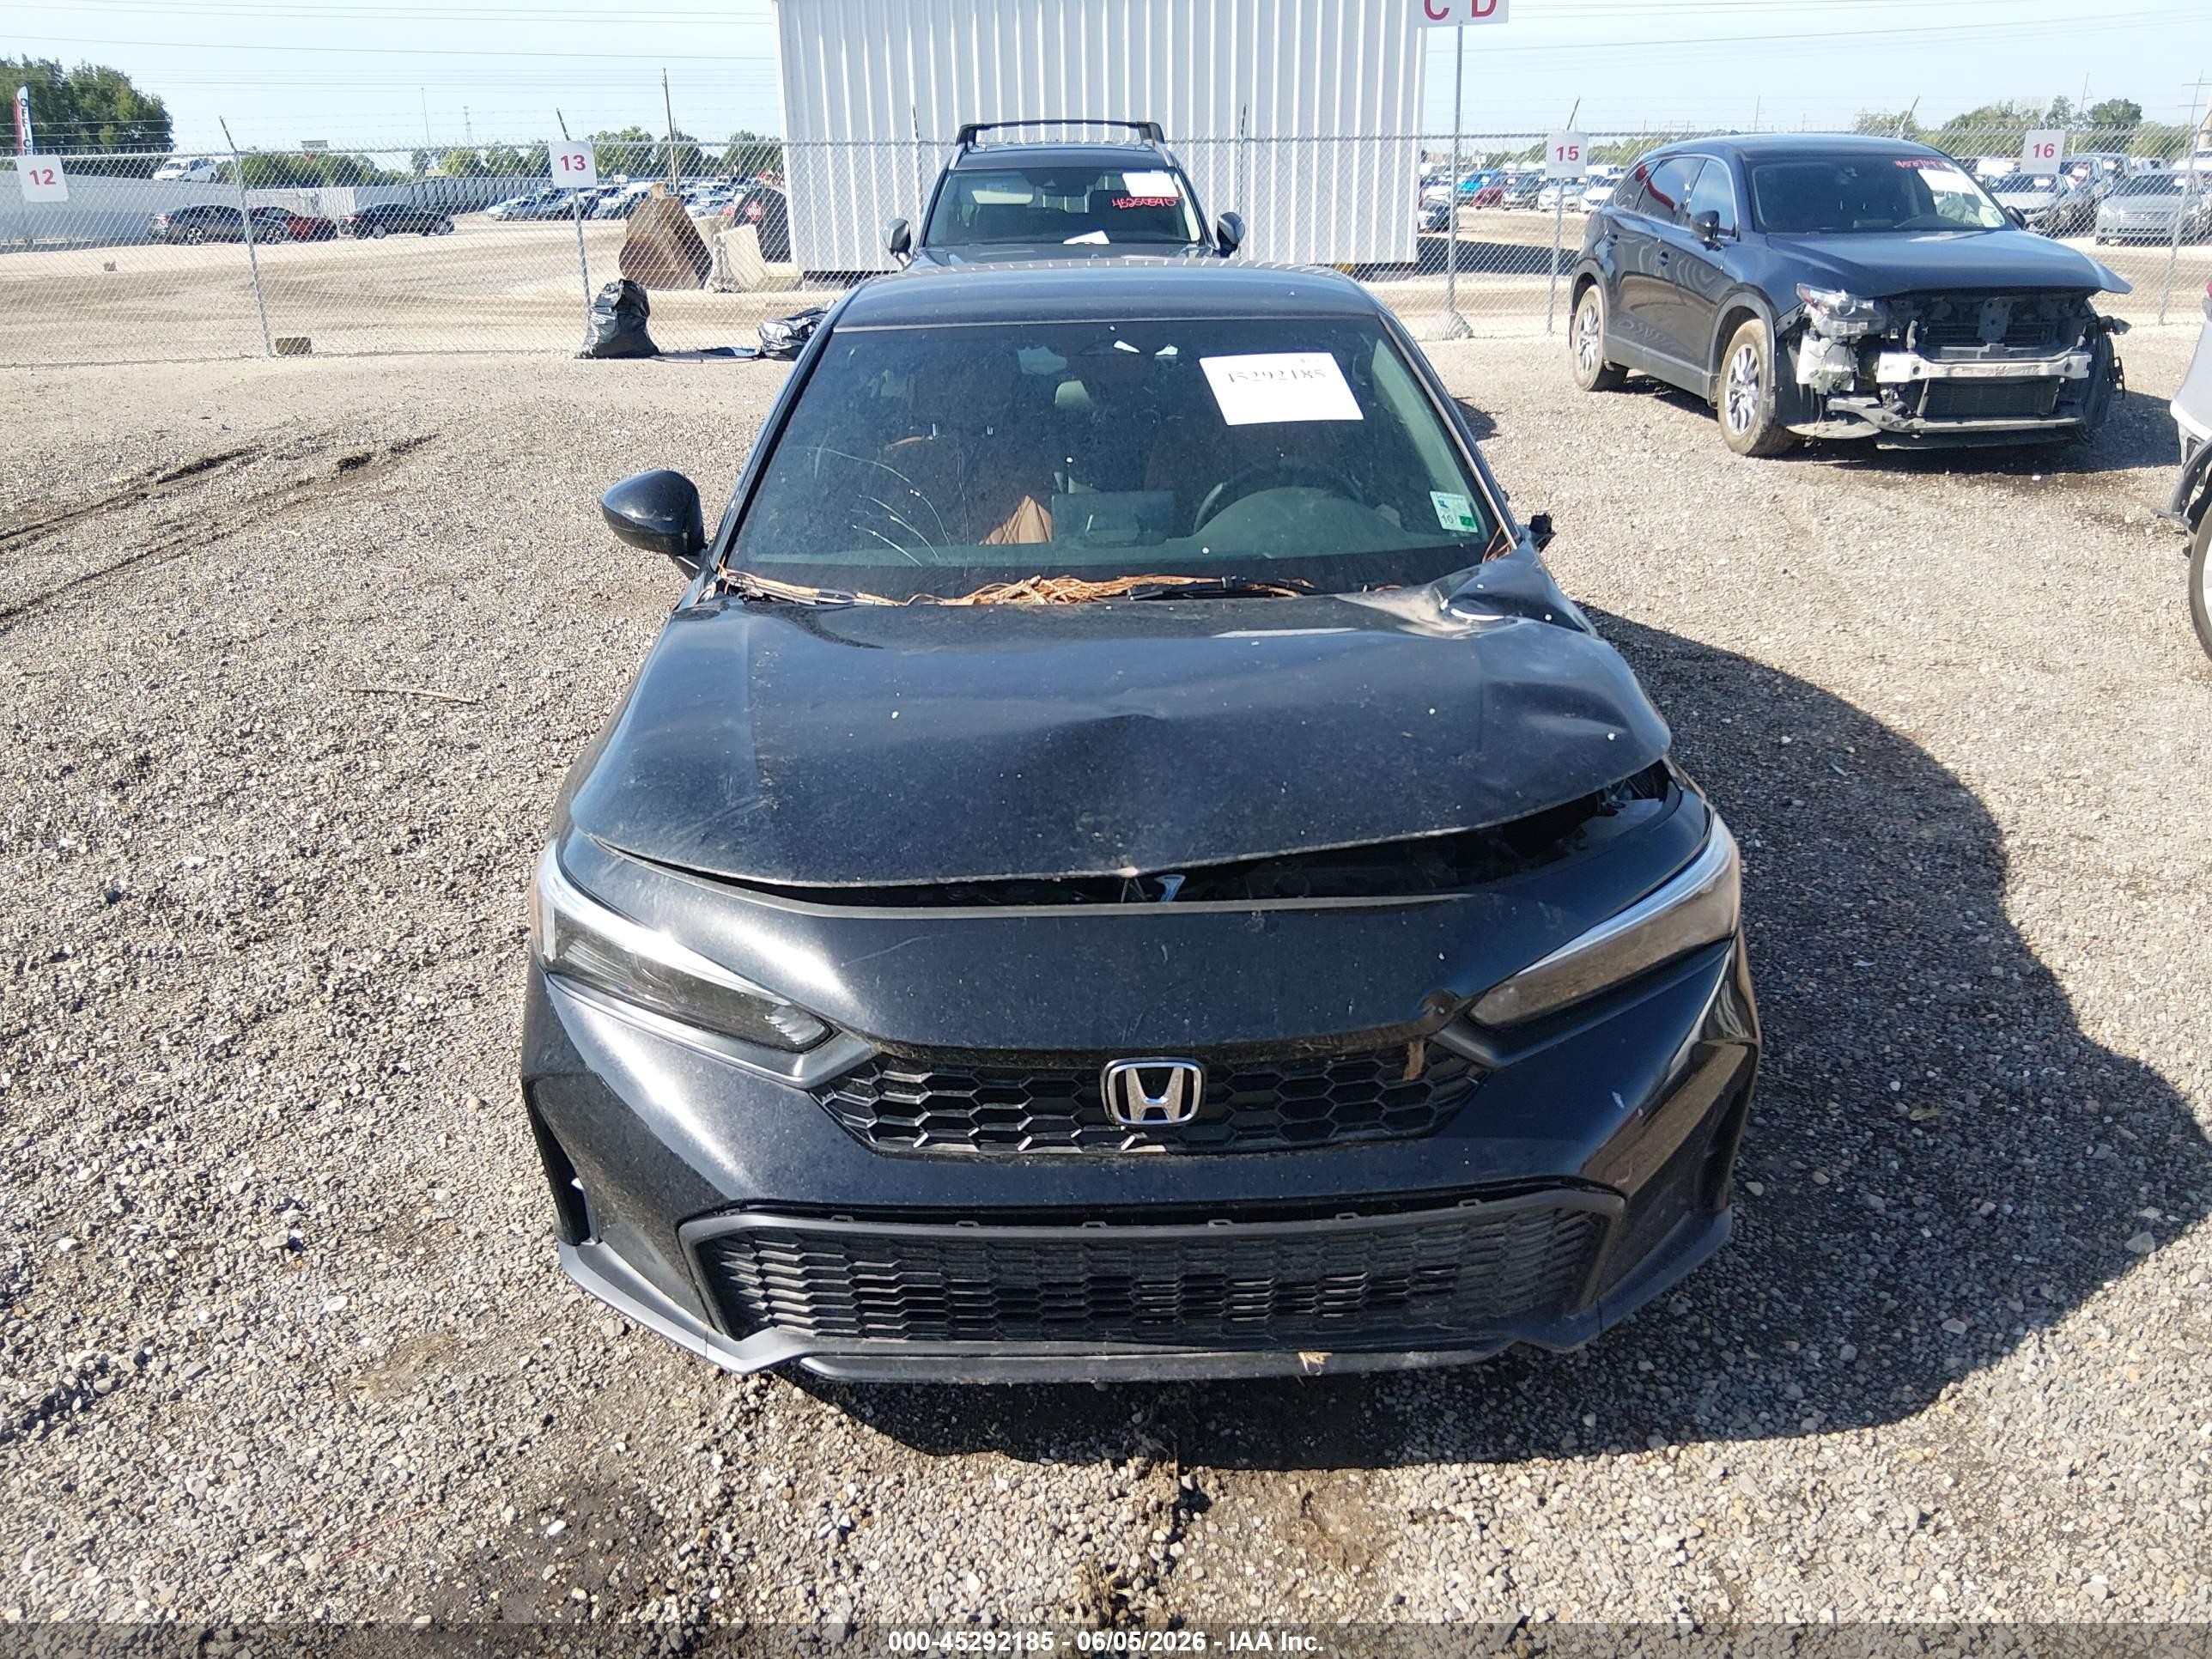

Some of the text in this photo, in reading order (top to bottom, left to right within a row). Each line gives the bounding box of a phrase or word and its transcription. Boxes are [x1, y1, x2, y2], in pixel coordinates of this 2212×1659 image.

[1556, 145, 1579, 161] 15
[2033, 143, 2055, 159] 16
[560, 154, 586, 172] 13
[29, 168, 57, 185] 12
